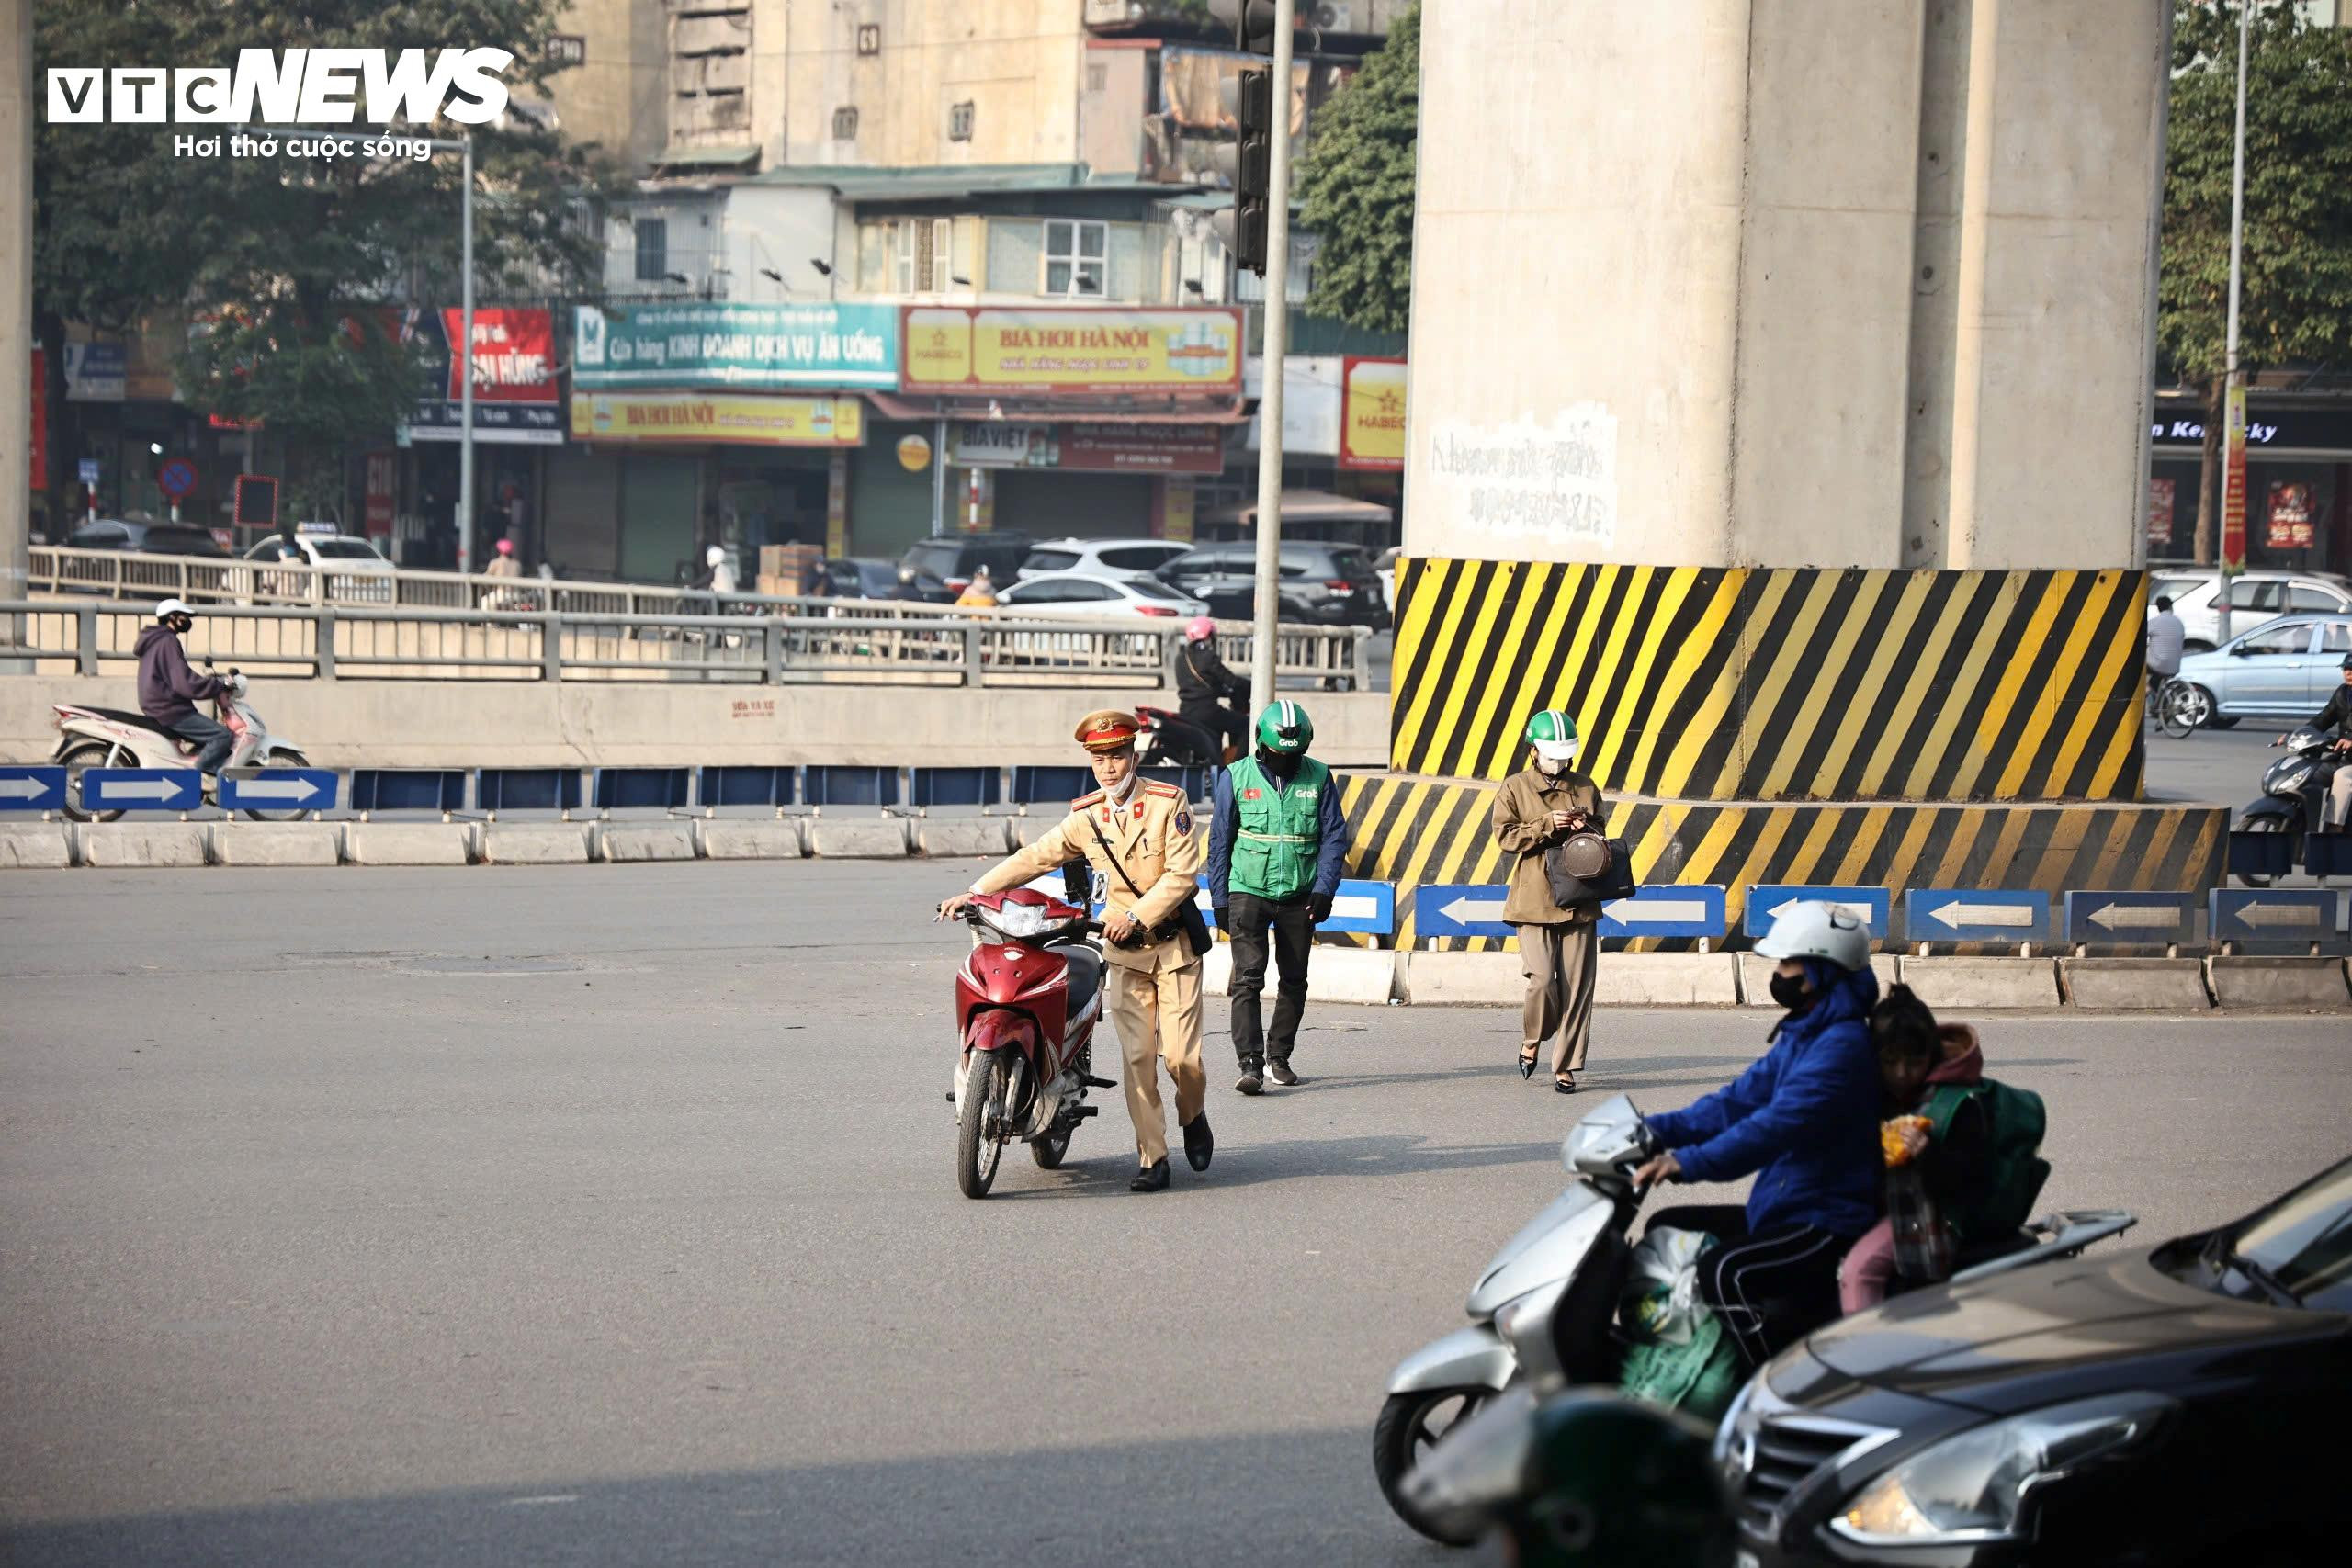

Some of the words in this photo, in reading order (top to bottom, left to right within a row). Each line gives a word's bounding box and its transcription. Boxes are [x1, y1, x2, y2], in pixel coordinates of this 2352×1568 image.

[668, 334, 699, 359] KINH
[703, 333, 752, 359] DOANH
[754, 334, 789, 365] DỊCH
[791, 334, 814, 367] VỤ
[842, 328, 884, 362] UỐNG
[1000, 330, 1033, 347] BIA
[1080, 325, 1109, 348] HÀ
[1113, 325, 1149, 351] NỘI
[962, 425, 989, 446] BIA
[989, 425, 1025, 448] VIỆT
[1279, 739, 1298, 747] Grab
[1295, 789, 1318, 798] Grab
